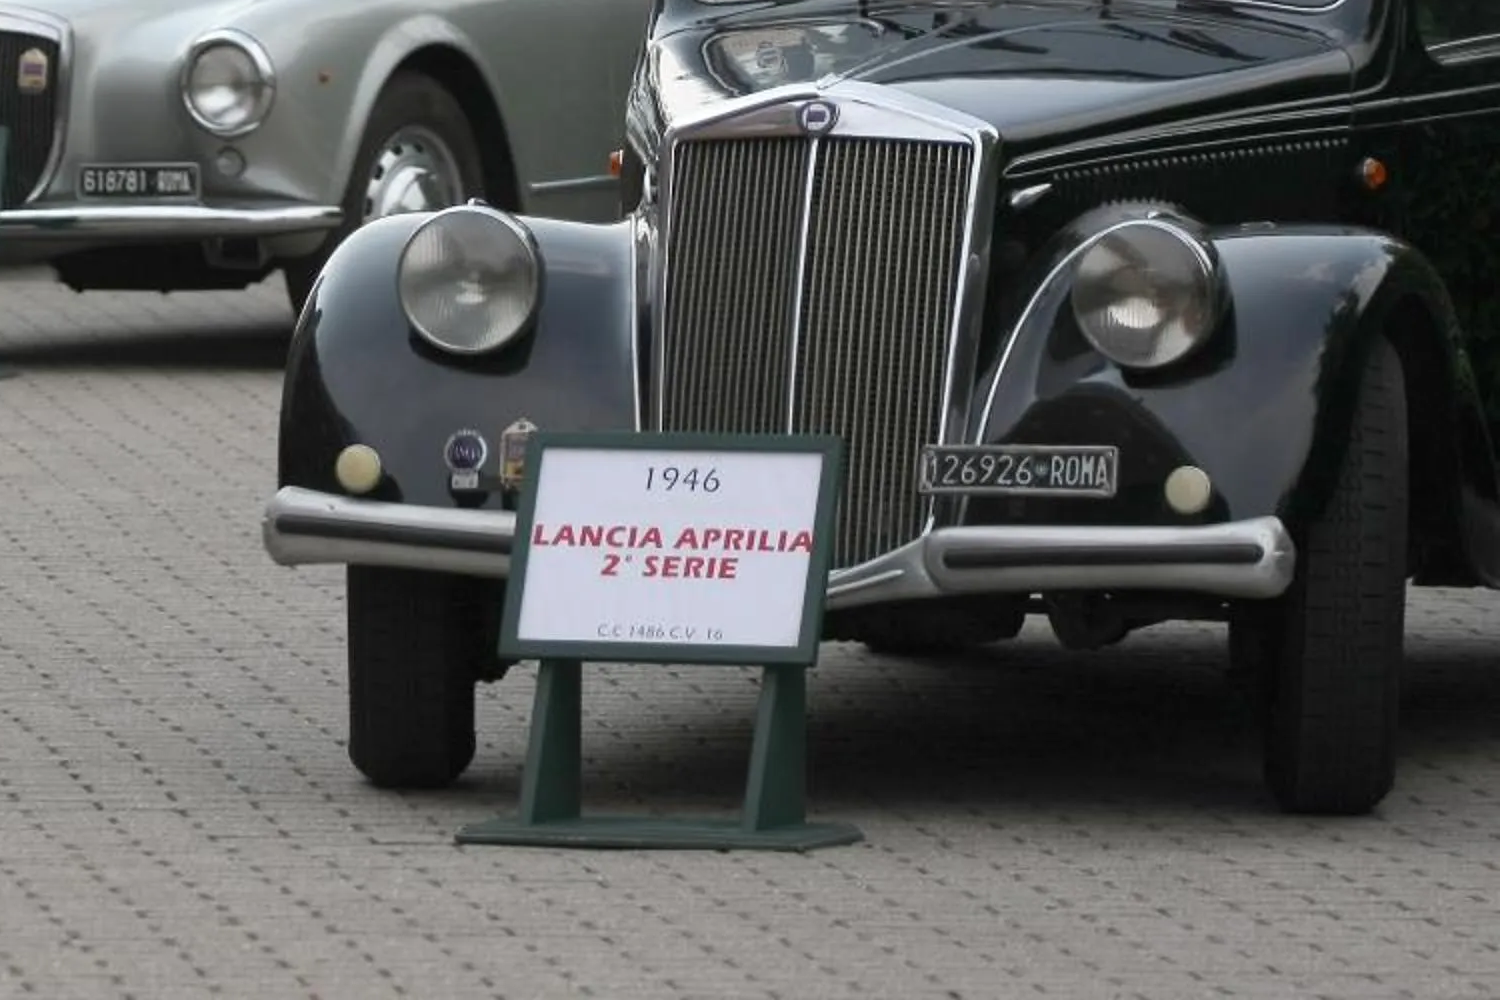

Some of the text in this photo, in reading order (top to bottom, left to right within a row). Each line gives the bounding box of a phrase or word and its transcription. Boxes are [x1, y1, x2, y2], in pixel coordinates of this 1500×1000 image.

[645, 466, 721, 493] 1946
[1050, 455, 1108, 487] ROMA
[532, 523, 815, 554] LANCIA APRILIA
[642, 555, 740, 580] SERIE
